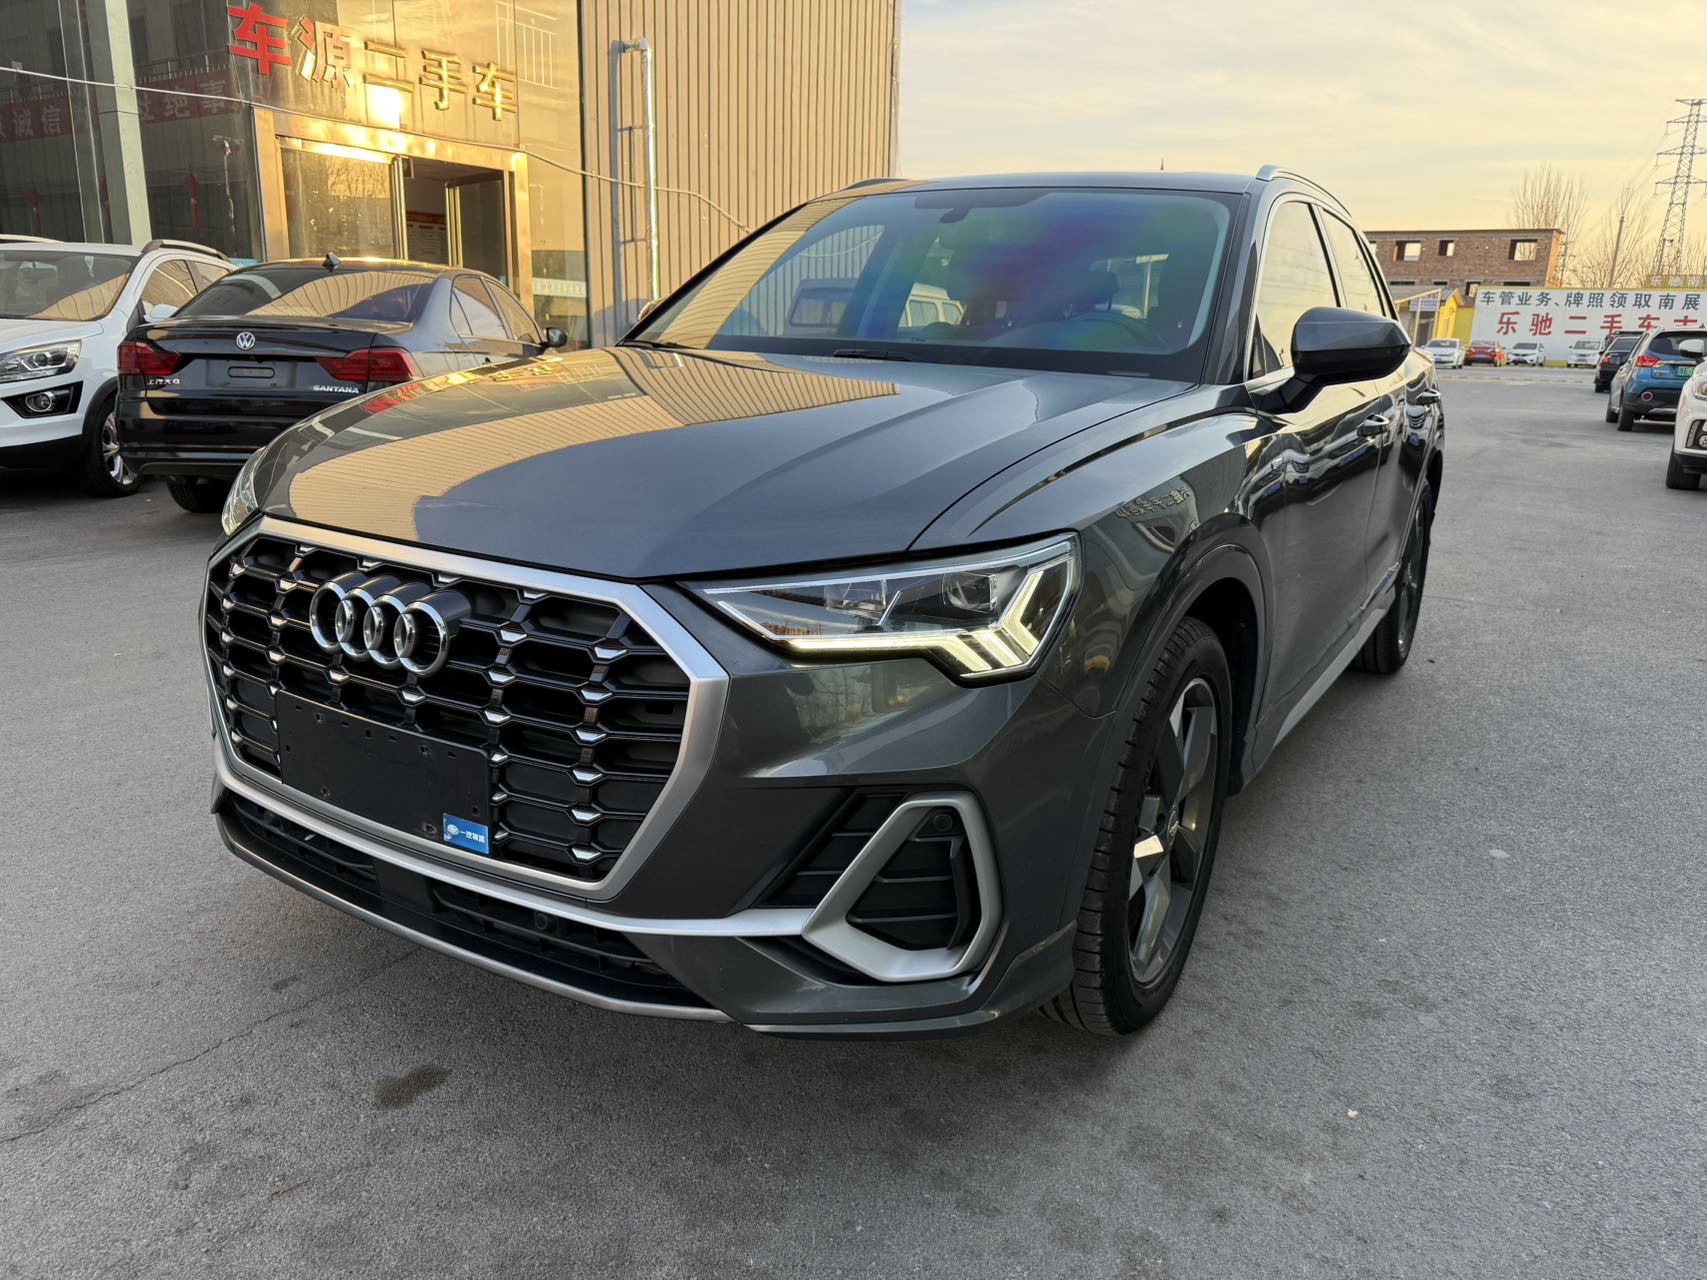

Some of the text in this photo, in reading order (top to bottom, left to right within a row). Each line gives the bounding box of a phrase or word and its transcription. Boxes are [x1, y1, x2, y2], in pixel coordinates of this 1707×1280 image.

[227, 3, 517, 121] 车源二手车
[312, 384, 360, 394] SANTANA
